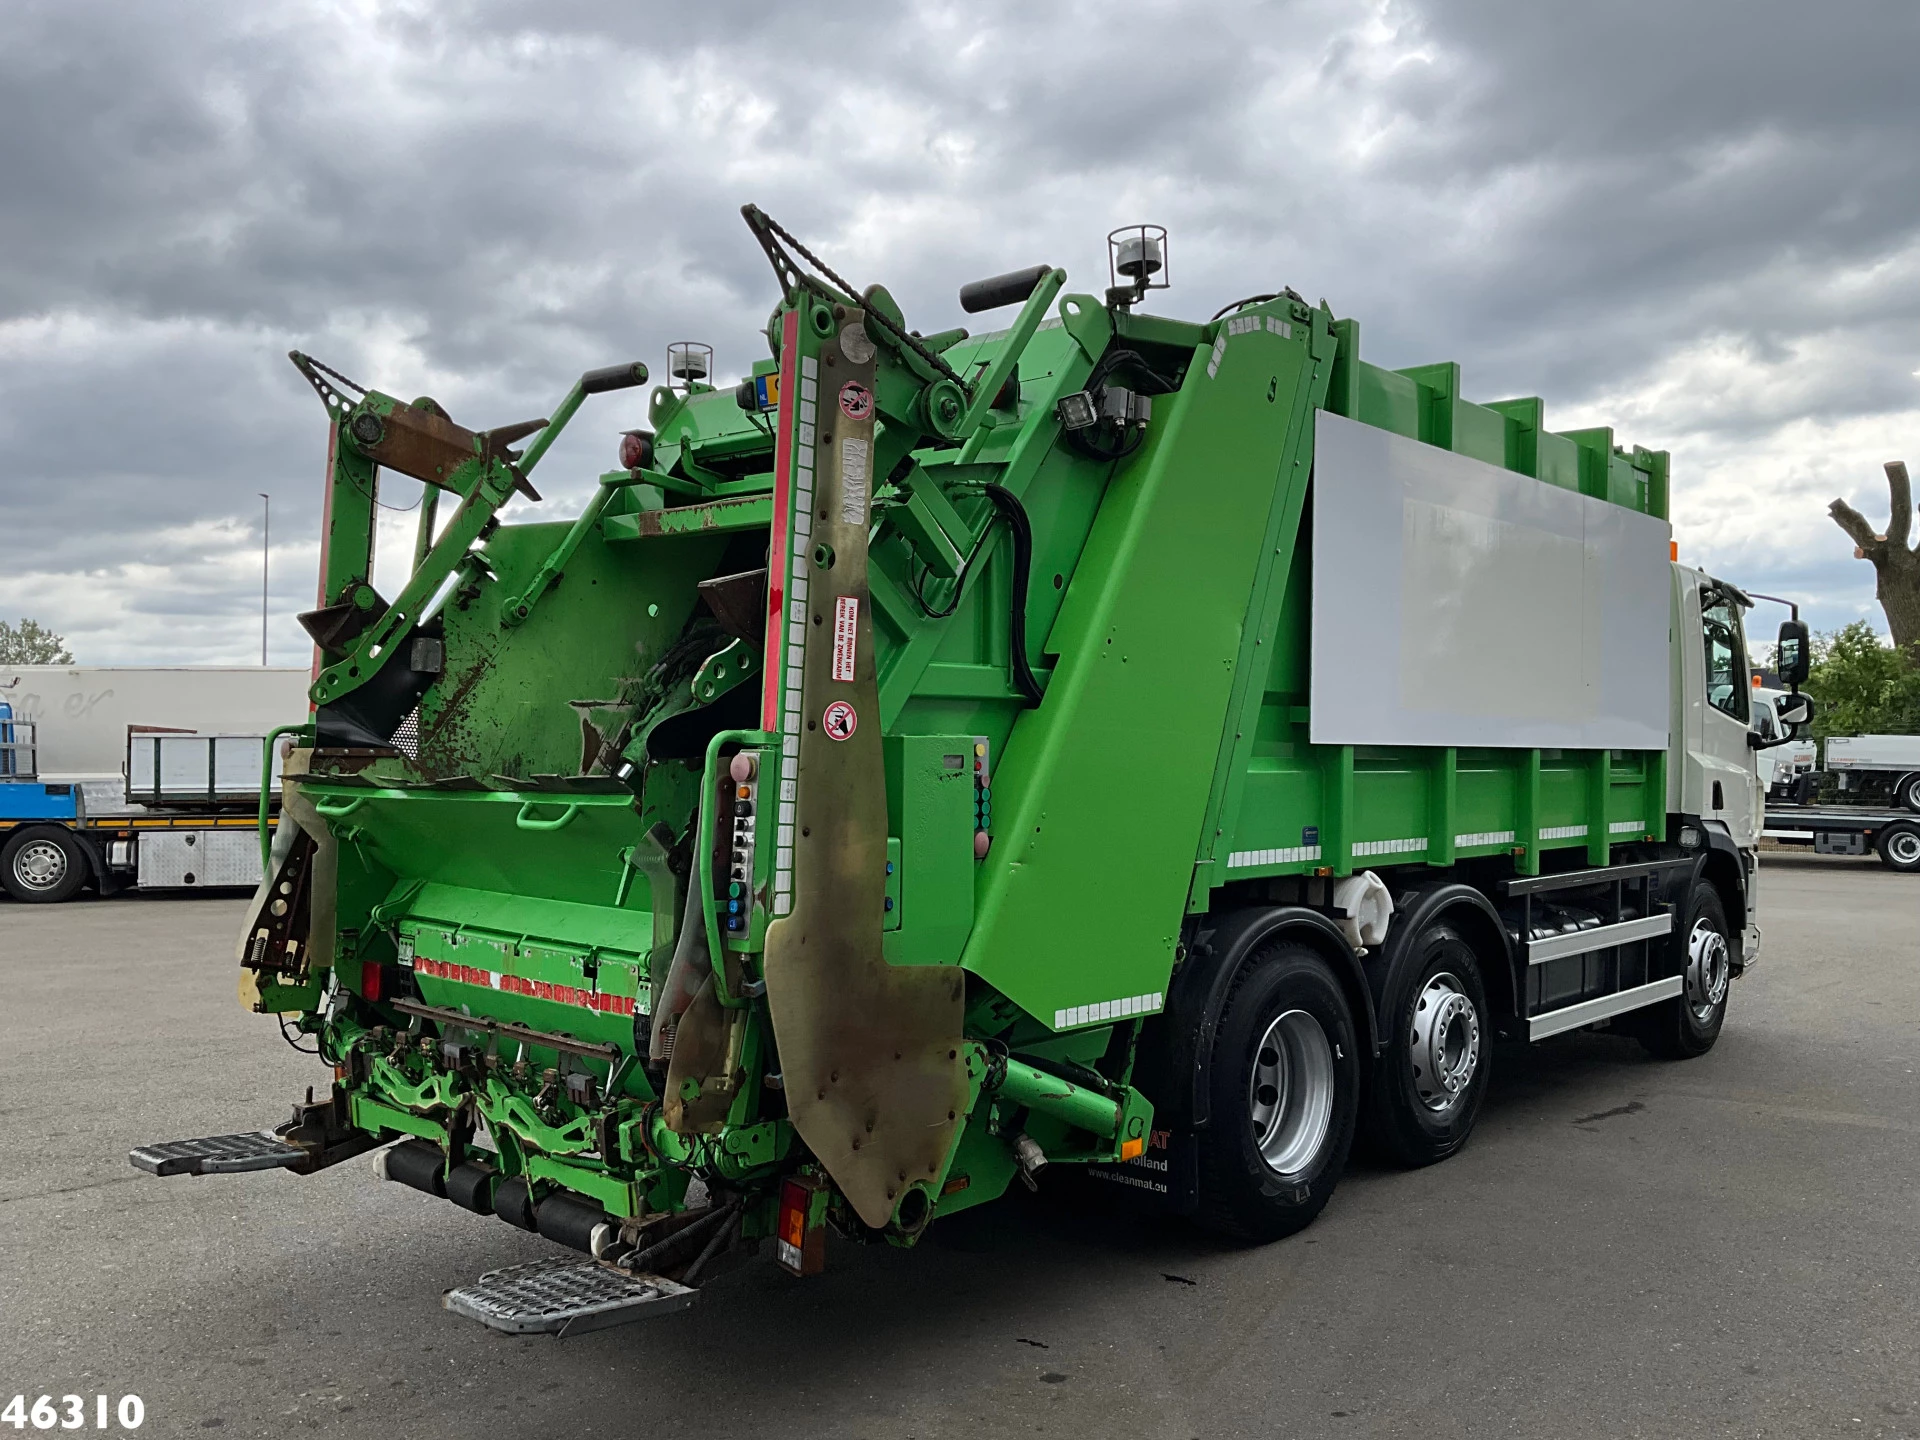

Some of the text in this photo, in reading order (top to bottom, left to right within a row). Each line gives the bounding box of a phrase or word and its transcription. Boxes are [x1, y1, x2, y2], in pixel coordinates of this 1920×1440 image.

[838, 634, 844, 642] DE
[845, 637, 853, 659] BINNEN
[1088, 1167, 1167, 1194] www.cleanmat.eu
